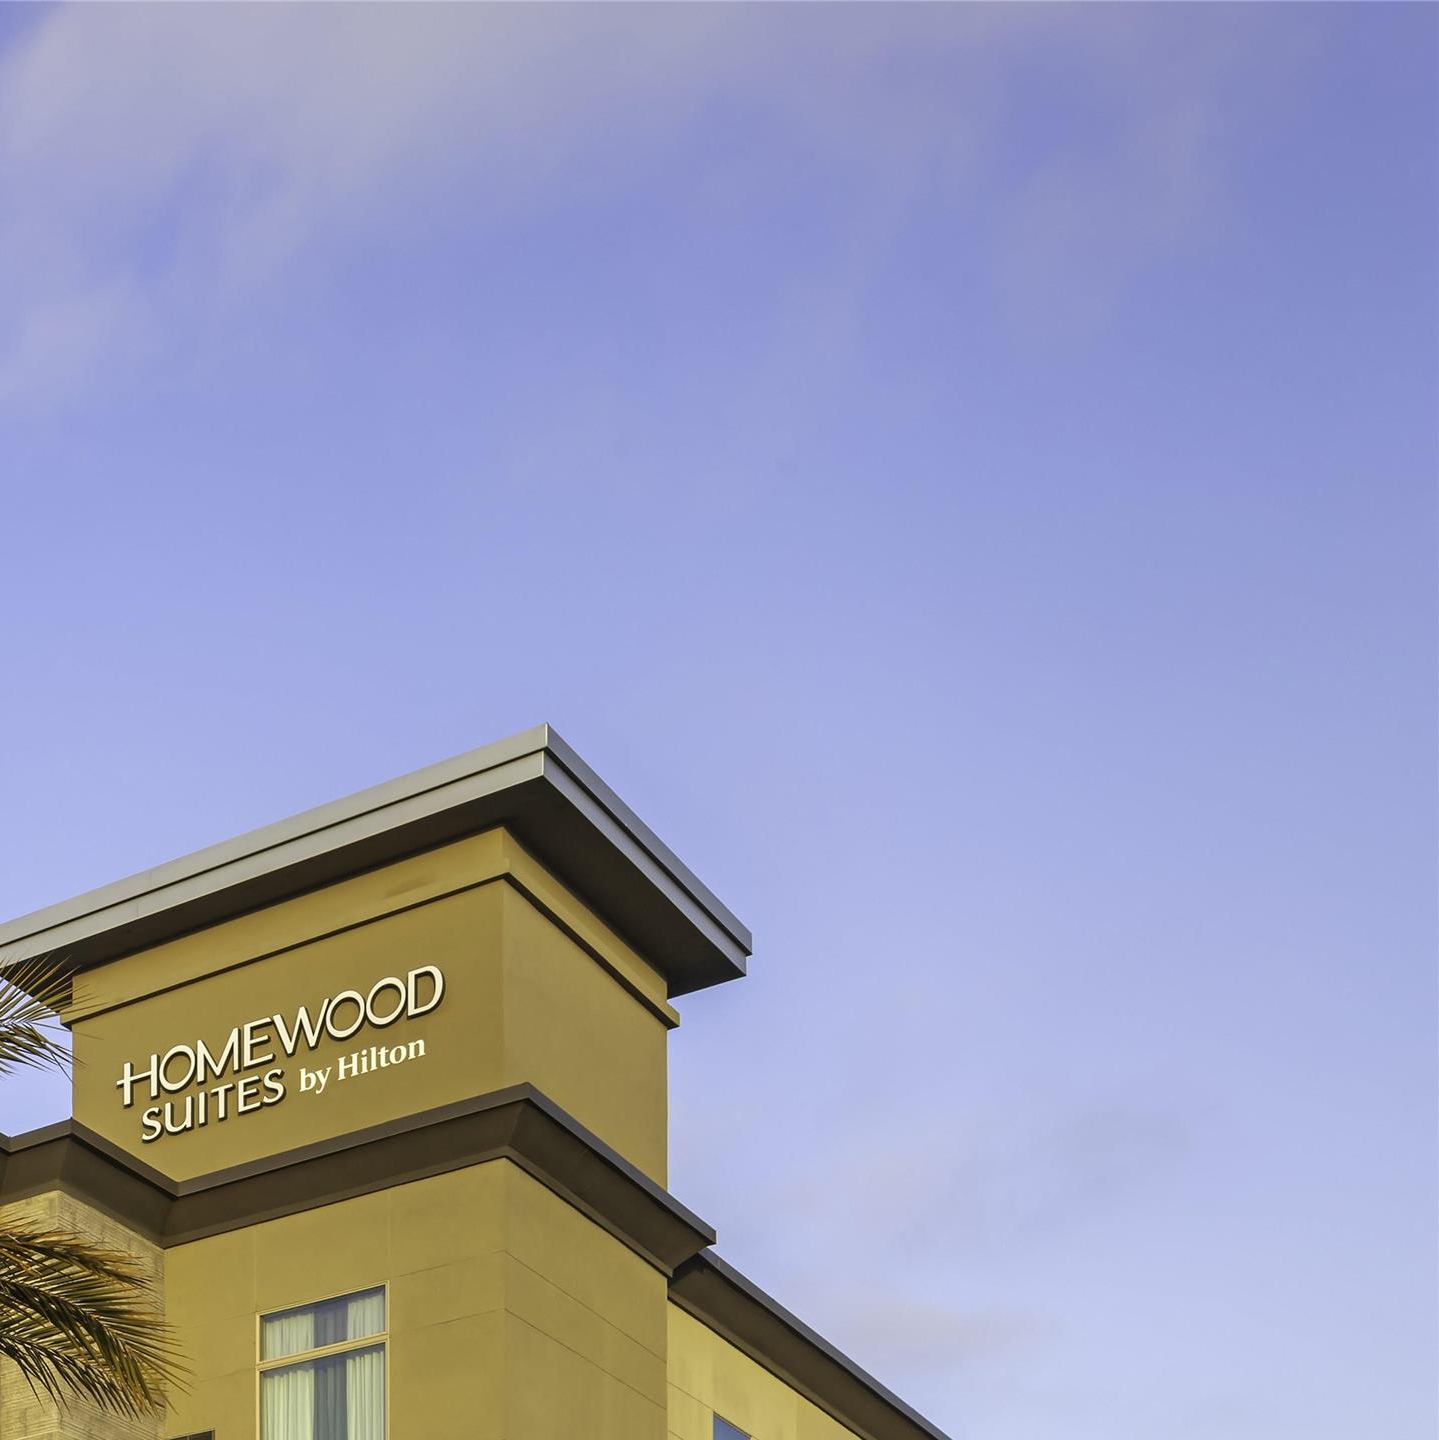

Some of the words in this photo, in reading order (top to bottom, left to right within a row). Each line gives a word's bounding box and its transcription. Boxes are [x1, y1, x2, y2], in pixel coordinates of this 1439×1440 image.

[116, 965, 445, 1107] HOMEWOOD
[141, 1068, 285, 1142] SUITES
[299, 1067, 332, 1095] by
[338, 1039, 426, 1081] Hilton
